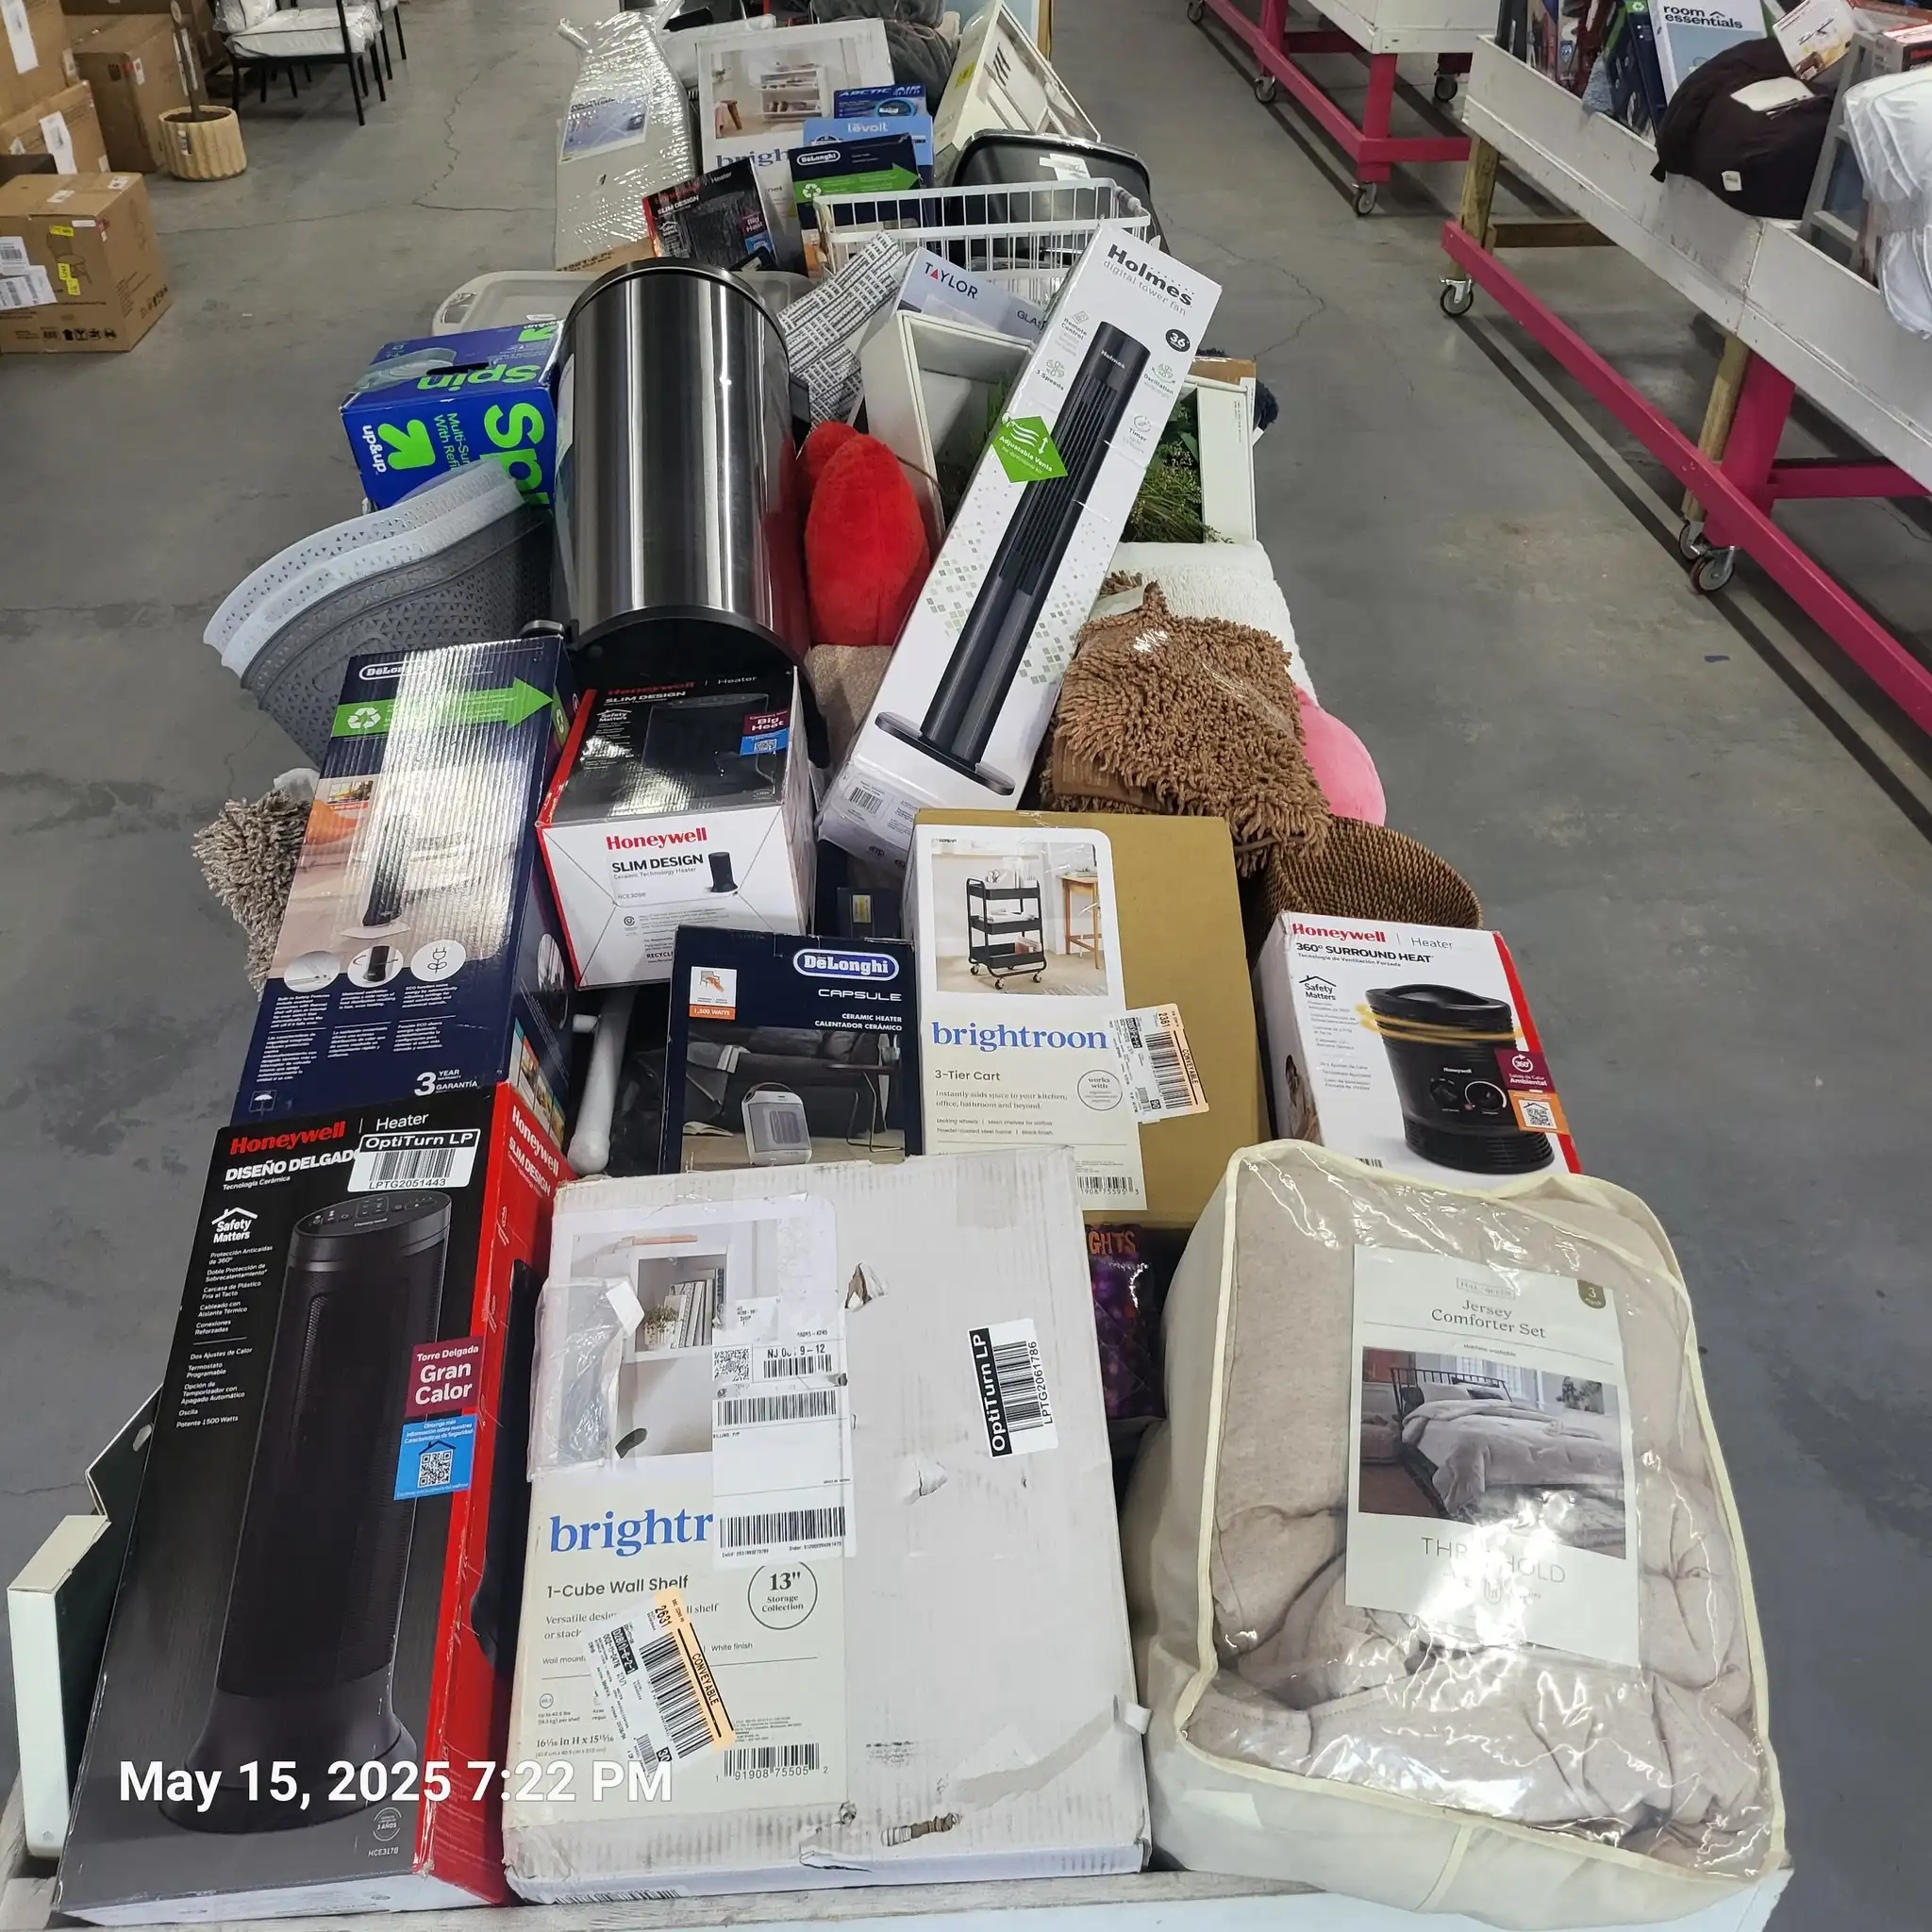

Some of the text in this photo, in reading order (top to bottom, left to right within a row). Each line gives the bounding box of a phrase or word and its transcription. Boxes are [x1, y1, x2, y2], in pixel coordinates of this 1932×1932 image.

[1663, 5, 1705, 17] room
[1665, 13, 1742, 29] essentials
[711, 172, 732, 183] Heater
[675, 195, 699, 208] DESIGN
[924, 261, 978, 300] TAYLOR
[1108, 243, 1193, 308] Holmes
[1104, 259, 1186, 317] digital tower fan
[1060, 322, 1085, 341] Control
[1063, 317, 1088, 337] Remote
[1101, 350, 1125, 370] Holmes
[417, 364, 541, 391] spin
[1041, 372, 1064, 391] Speeds
[1143, 374, 1174, 395] Oscillation
[433, 414, 449, 445] With
[1129, 427, 1147, 442] Timer
[362, 425, 387, 473] up&up
[999, 436, 1053, 472] Adjustable Vents
[608, 681, 695, 695] Honeywell
[638, 691, 686, 701] DESIGN
[751, 722, 785, 732] Heat
[606, 827, 708, 850] Honeywell
[612, 854, 704, 873] SLIM DESIGN
[640, 869, 675, 877] Technology
[1292, 924, 1386, 942] Honeywell
[1410, 937, 1453, 950] Heater
[1325, 945, 1396, 959] SURROUND
[1399, 954, 1431, 963] HEAT
[818, 989, 902, 1002] CAPSULE
[1305, 983, 1333, 993] Safety
[1306, 991, 1336, 1001] Matters
[864, 1023, 903, 1031] CERÁMICO
[1158, 1012, 1171, 1027] 2381
[1182, 1049, 1199, 1084] CONVEYABLE
[935, 1070, 1000, 1080] 3-Tier Cart
[414, 1072, 436, 1096] 3
[436, 1080, 478, 1091] GARANTÍA
[1038, 1091, 1068, 1101] kitchen,
[1014, 1102, 1042, 1111] beyond.
[230, 1113, 429, 1155] Honeywell Heater
[365, 1133, 473, 1149] OptiTurn LP
[512, 1106, 559, 1177] Honeywell
[225, 1159, 285, 1182] DISEÑO
[508, 1136, 525, 1166] SLIM
[525, 1159, 551, 1197] DESIGN
[223, 1175, 291, 1191] Tecnología Cerámica
[369, 1178, 446, 1190] LPTG2051443
[216, 1219, 252, 1232] Safety
[213, 1231, 250, 1243] Matters
[210, 1250, 242, 1258] Protección
[225, 1265, 257, 1274] Protección
[1588, 1287, 1596, 1298] 3
[1462, 1299, 1513, 1319] Jersey
[196, 1320, 231, 1329] Conexiones
[1431, 1308, 1547, 1339] Comforter Set
[195, 1327, 228, 1336] Reforzadas
[204, 1351, 225, 1359] Ajustes
[417, 1345, 479, 1362] Torre Delgada
[767, 1349, 779, 1358] NJ
[187, 1369, 226, 1378] Programable
[420, 1362, 472, 1383] Gran
[1027, 1341, 1054, 1426] LPTG2061786
[415, 1383, 473, 1406] Calor
[972, 1332, 1006, 1453] OptiTurn LP
[181, 1396, 208, 1405] Apagado
[547, 1574, 689, 1598] 1-Cube Wall Shelf
[766, 1595, 799, 1605] Storage
[694, 1603, 719, 1613] shelf
[761, 1603, 804, 1613] Collection
[545, 1614, 591, 1624] Versatile
[655, 1605, 673, 1627] 2631
[734, 1641, 753, 1650] finish
[691, 1653, 719, 1707] CONVEYABLE
[735, 1769, 769, 1781] 91908
[775, 1766, 809, 1778] 75505
